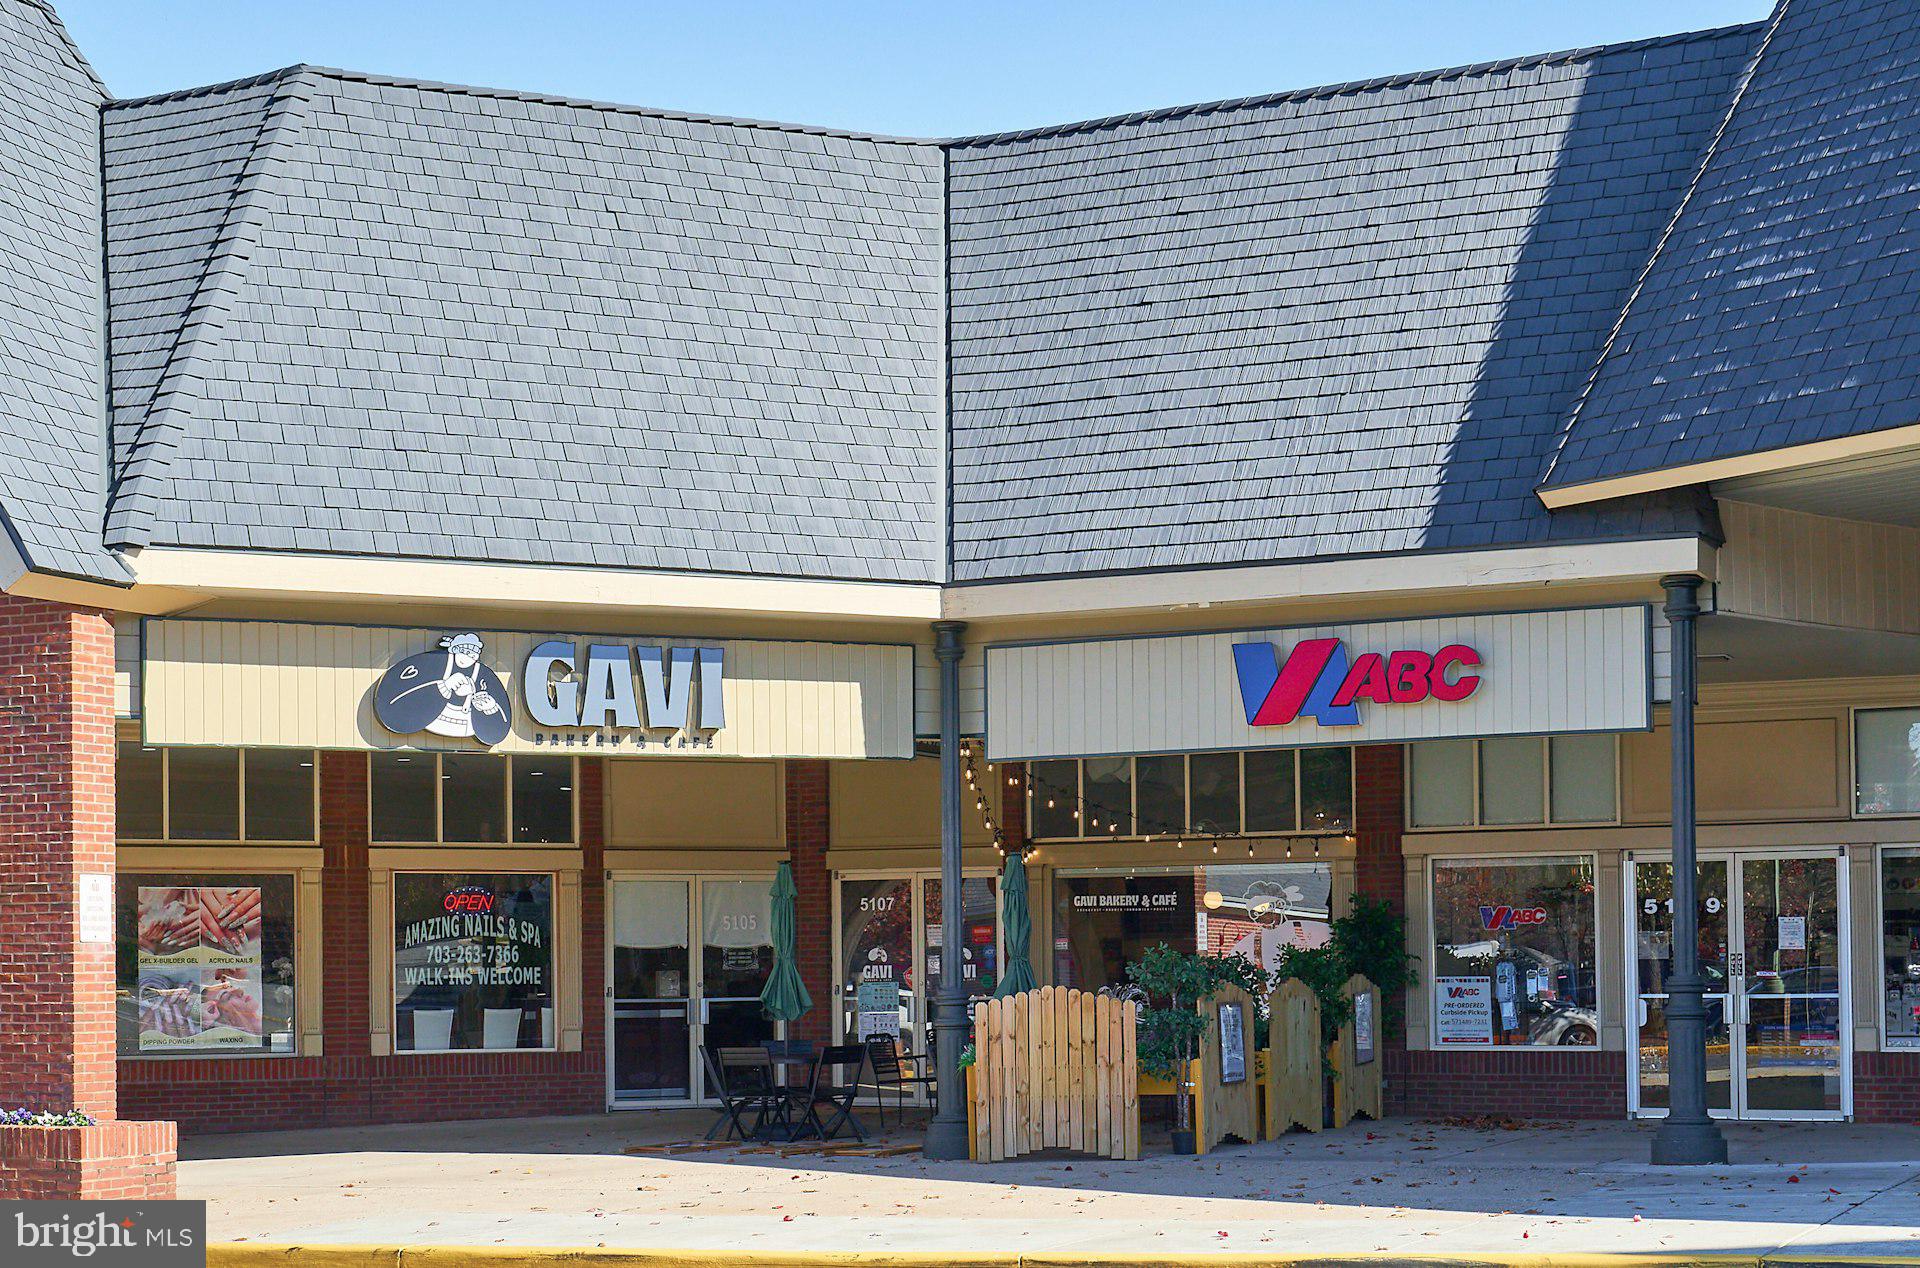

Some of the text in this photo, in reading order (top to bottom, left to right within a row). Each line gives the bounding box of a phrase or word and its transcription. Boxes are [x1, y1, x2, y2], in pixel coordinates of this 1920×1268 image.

[524, 641, 725, 728] GAVI
[535, 733, 714, 749] BAKERY & CAFÉ
[443, 893, 495, 911] OPEN
[860, 897, 895, 912] 5107
[1073, 891, 1178, 907] GAVI BAKERY & CAFÉ
[1644, 897, 1721, 915] 519
[723, 914, 758, 930] 5105
[404, 914, 542, 949] AMAZING NAILS & SPA
[426, 945, 520, 964] 703-263-7366
[404, 966, 542, 986] WALK-INS WELCOME
[862, 964, 893, 979] GAVI
[1467, 1009, 1489, 1017] Pickup
